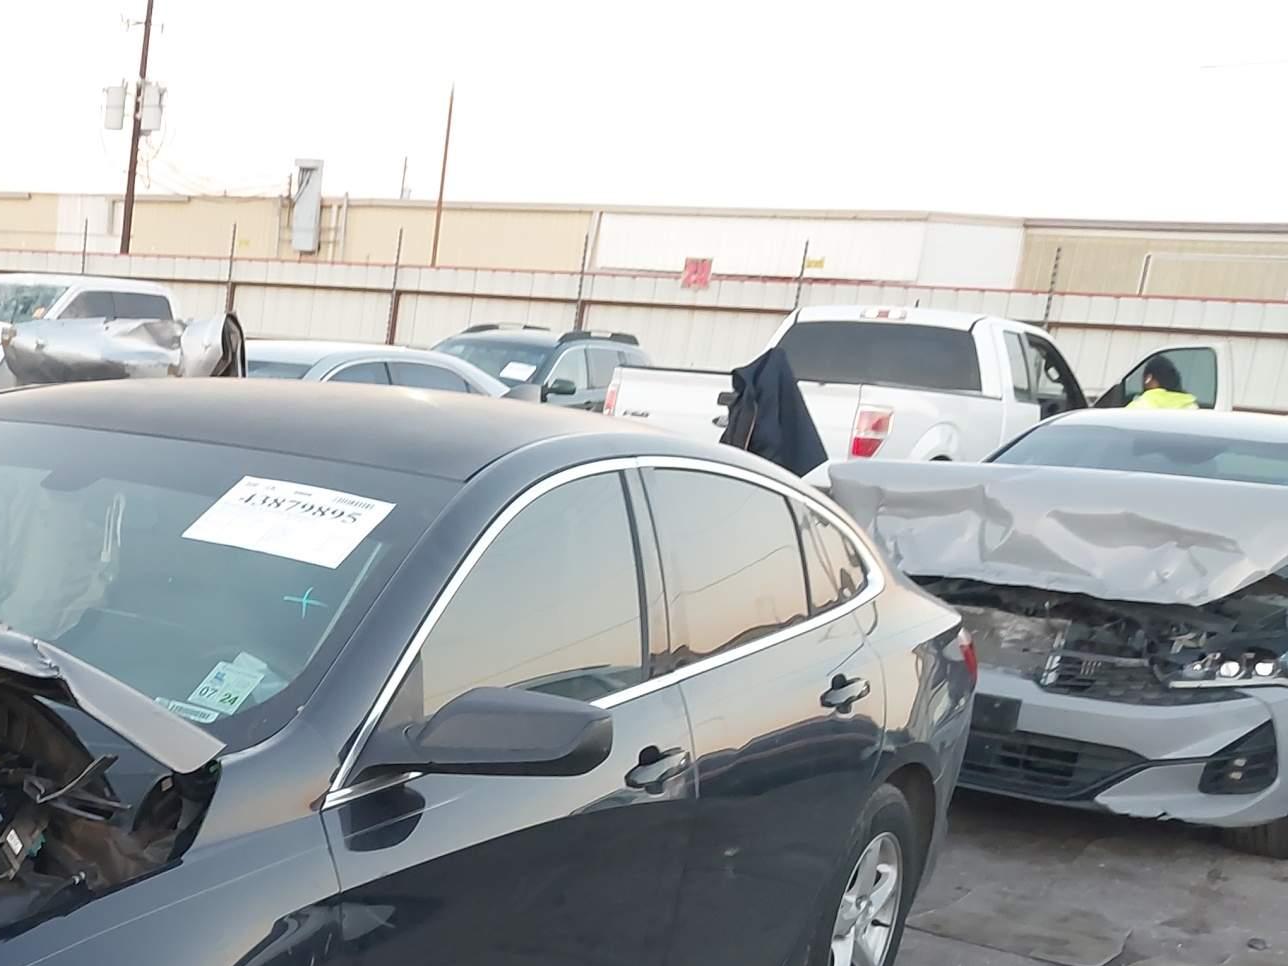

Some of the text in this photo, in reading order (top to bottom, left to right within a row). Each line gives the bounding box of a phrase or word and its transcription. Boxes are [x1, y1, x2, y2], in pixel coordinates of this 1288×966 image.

[239, 493, 362, 524] 43879895
[199, 686, 239, 706] 07 24
